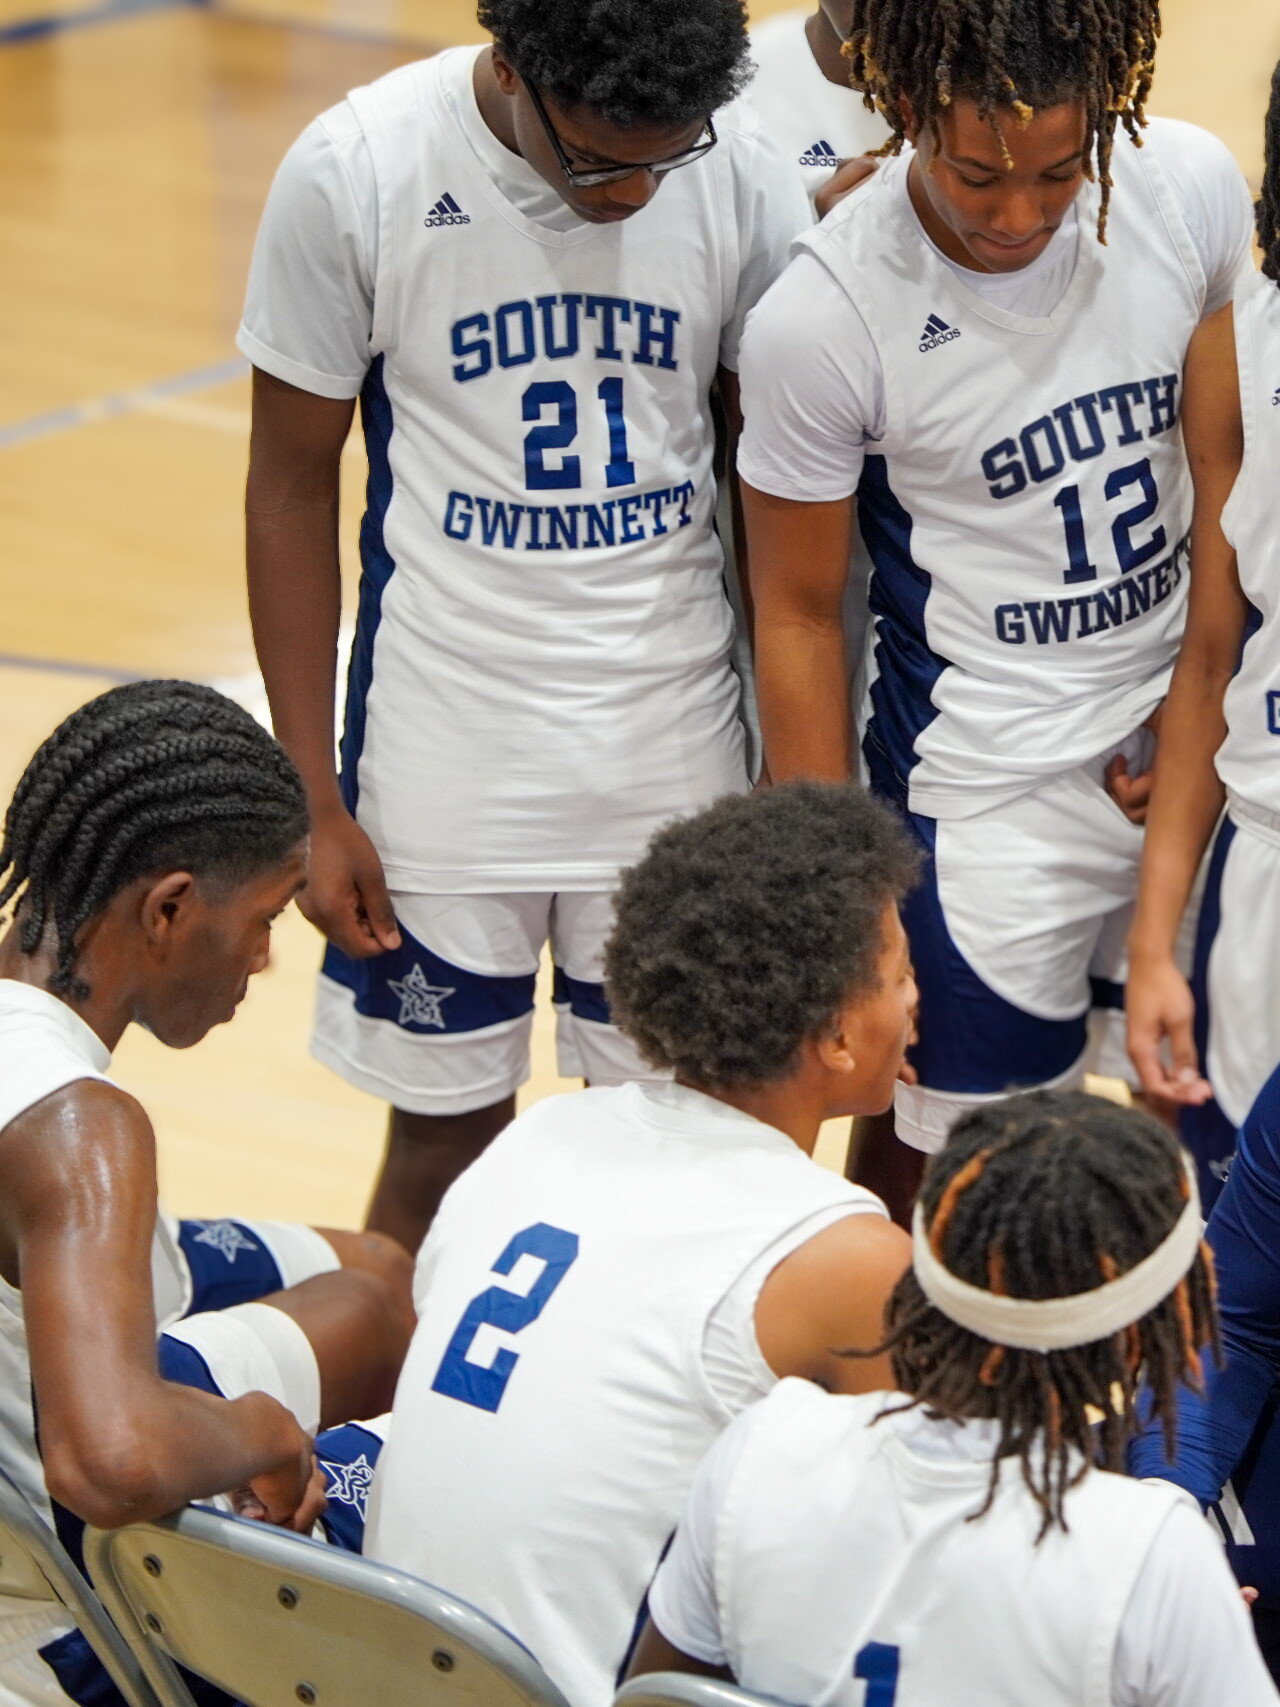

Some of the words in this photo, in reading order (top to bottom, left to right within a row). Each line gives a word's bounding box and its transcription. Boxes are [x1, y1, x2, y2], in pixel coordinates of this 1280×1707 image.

[424, 213, 471, 227] adidas
[450, 291, 681, 384] SOUTH
[919, 328, 961, 352] adidas
[521, 376, 637, 491] 21
[980, 373, 1178, 500] SOUTH
[443, 478, 696, 551] GWINNETT
[1053, 457, 1166, 585] 12
[430, 1222, 580, 1415] 2
